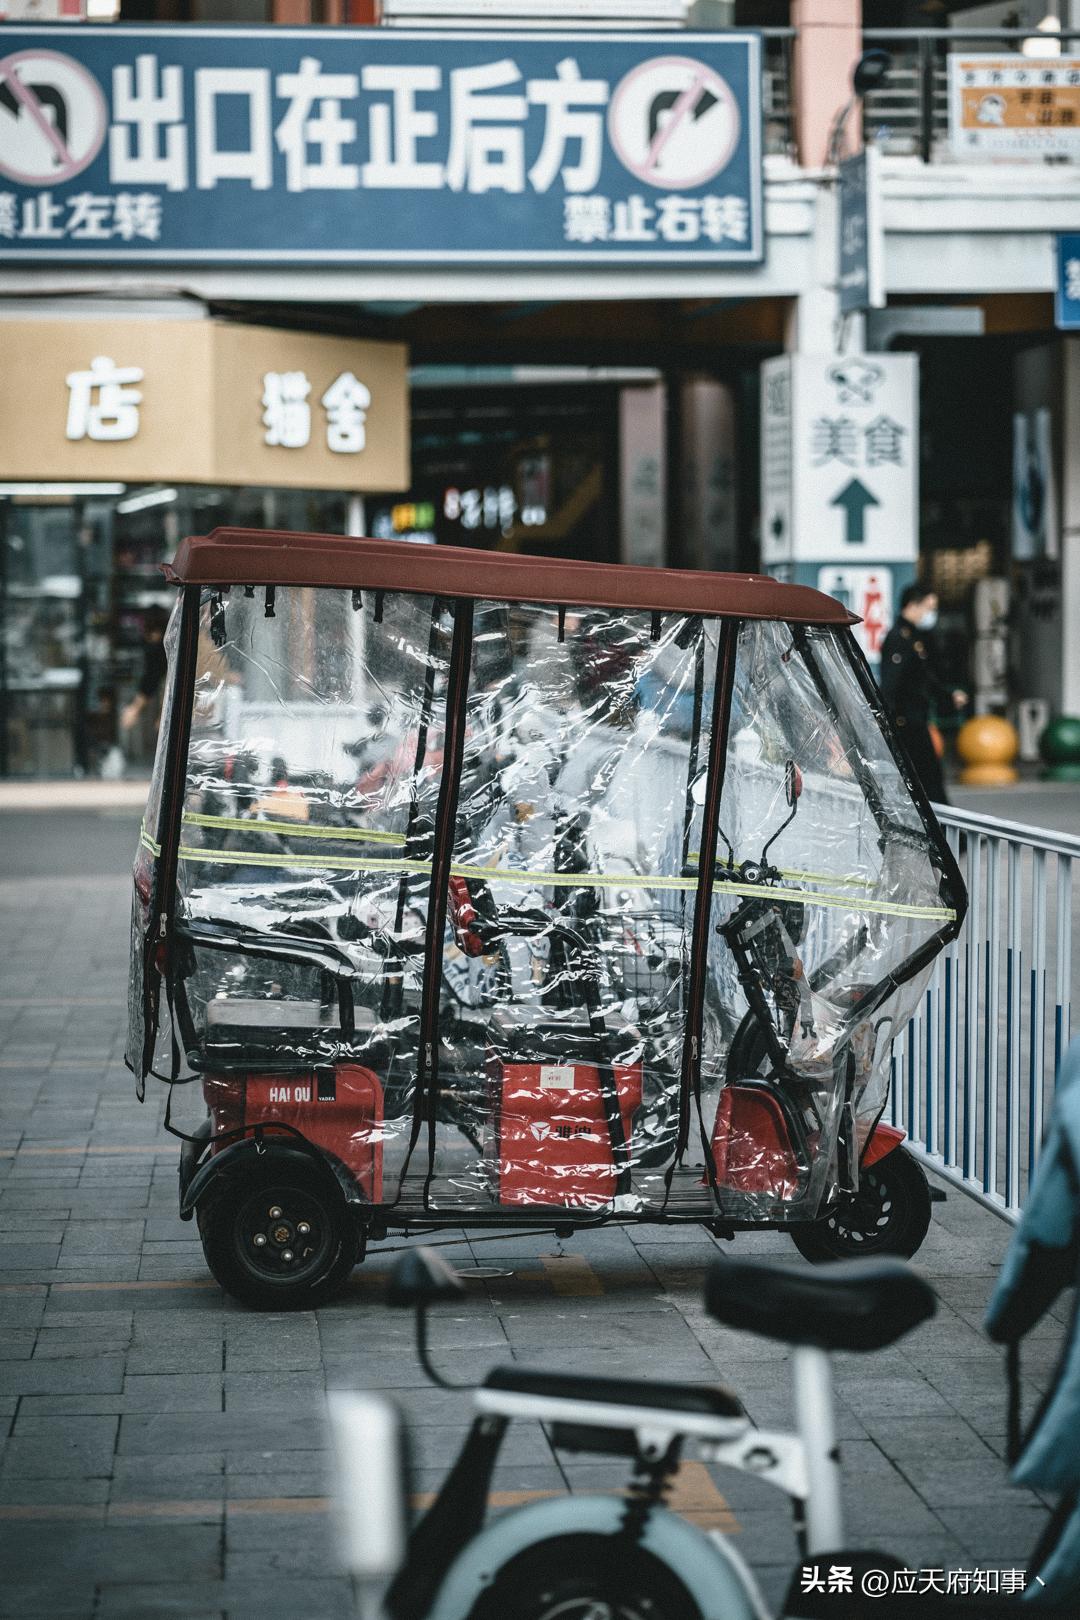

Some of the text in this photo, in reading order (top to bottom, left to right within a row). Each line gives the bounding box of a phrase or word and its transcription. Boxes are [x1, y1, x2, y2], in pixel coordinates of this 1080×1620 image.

[109, 54, 609, 193] 出口在正后方
[564, 195, 748, 243] 禁止右转
[66, 356, 144, 441] 店
[262, 370, 371, 453] 猫舍
[811, 414, 906, 468] 美食
